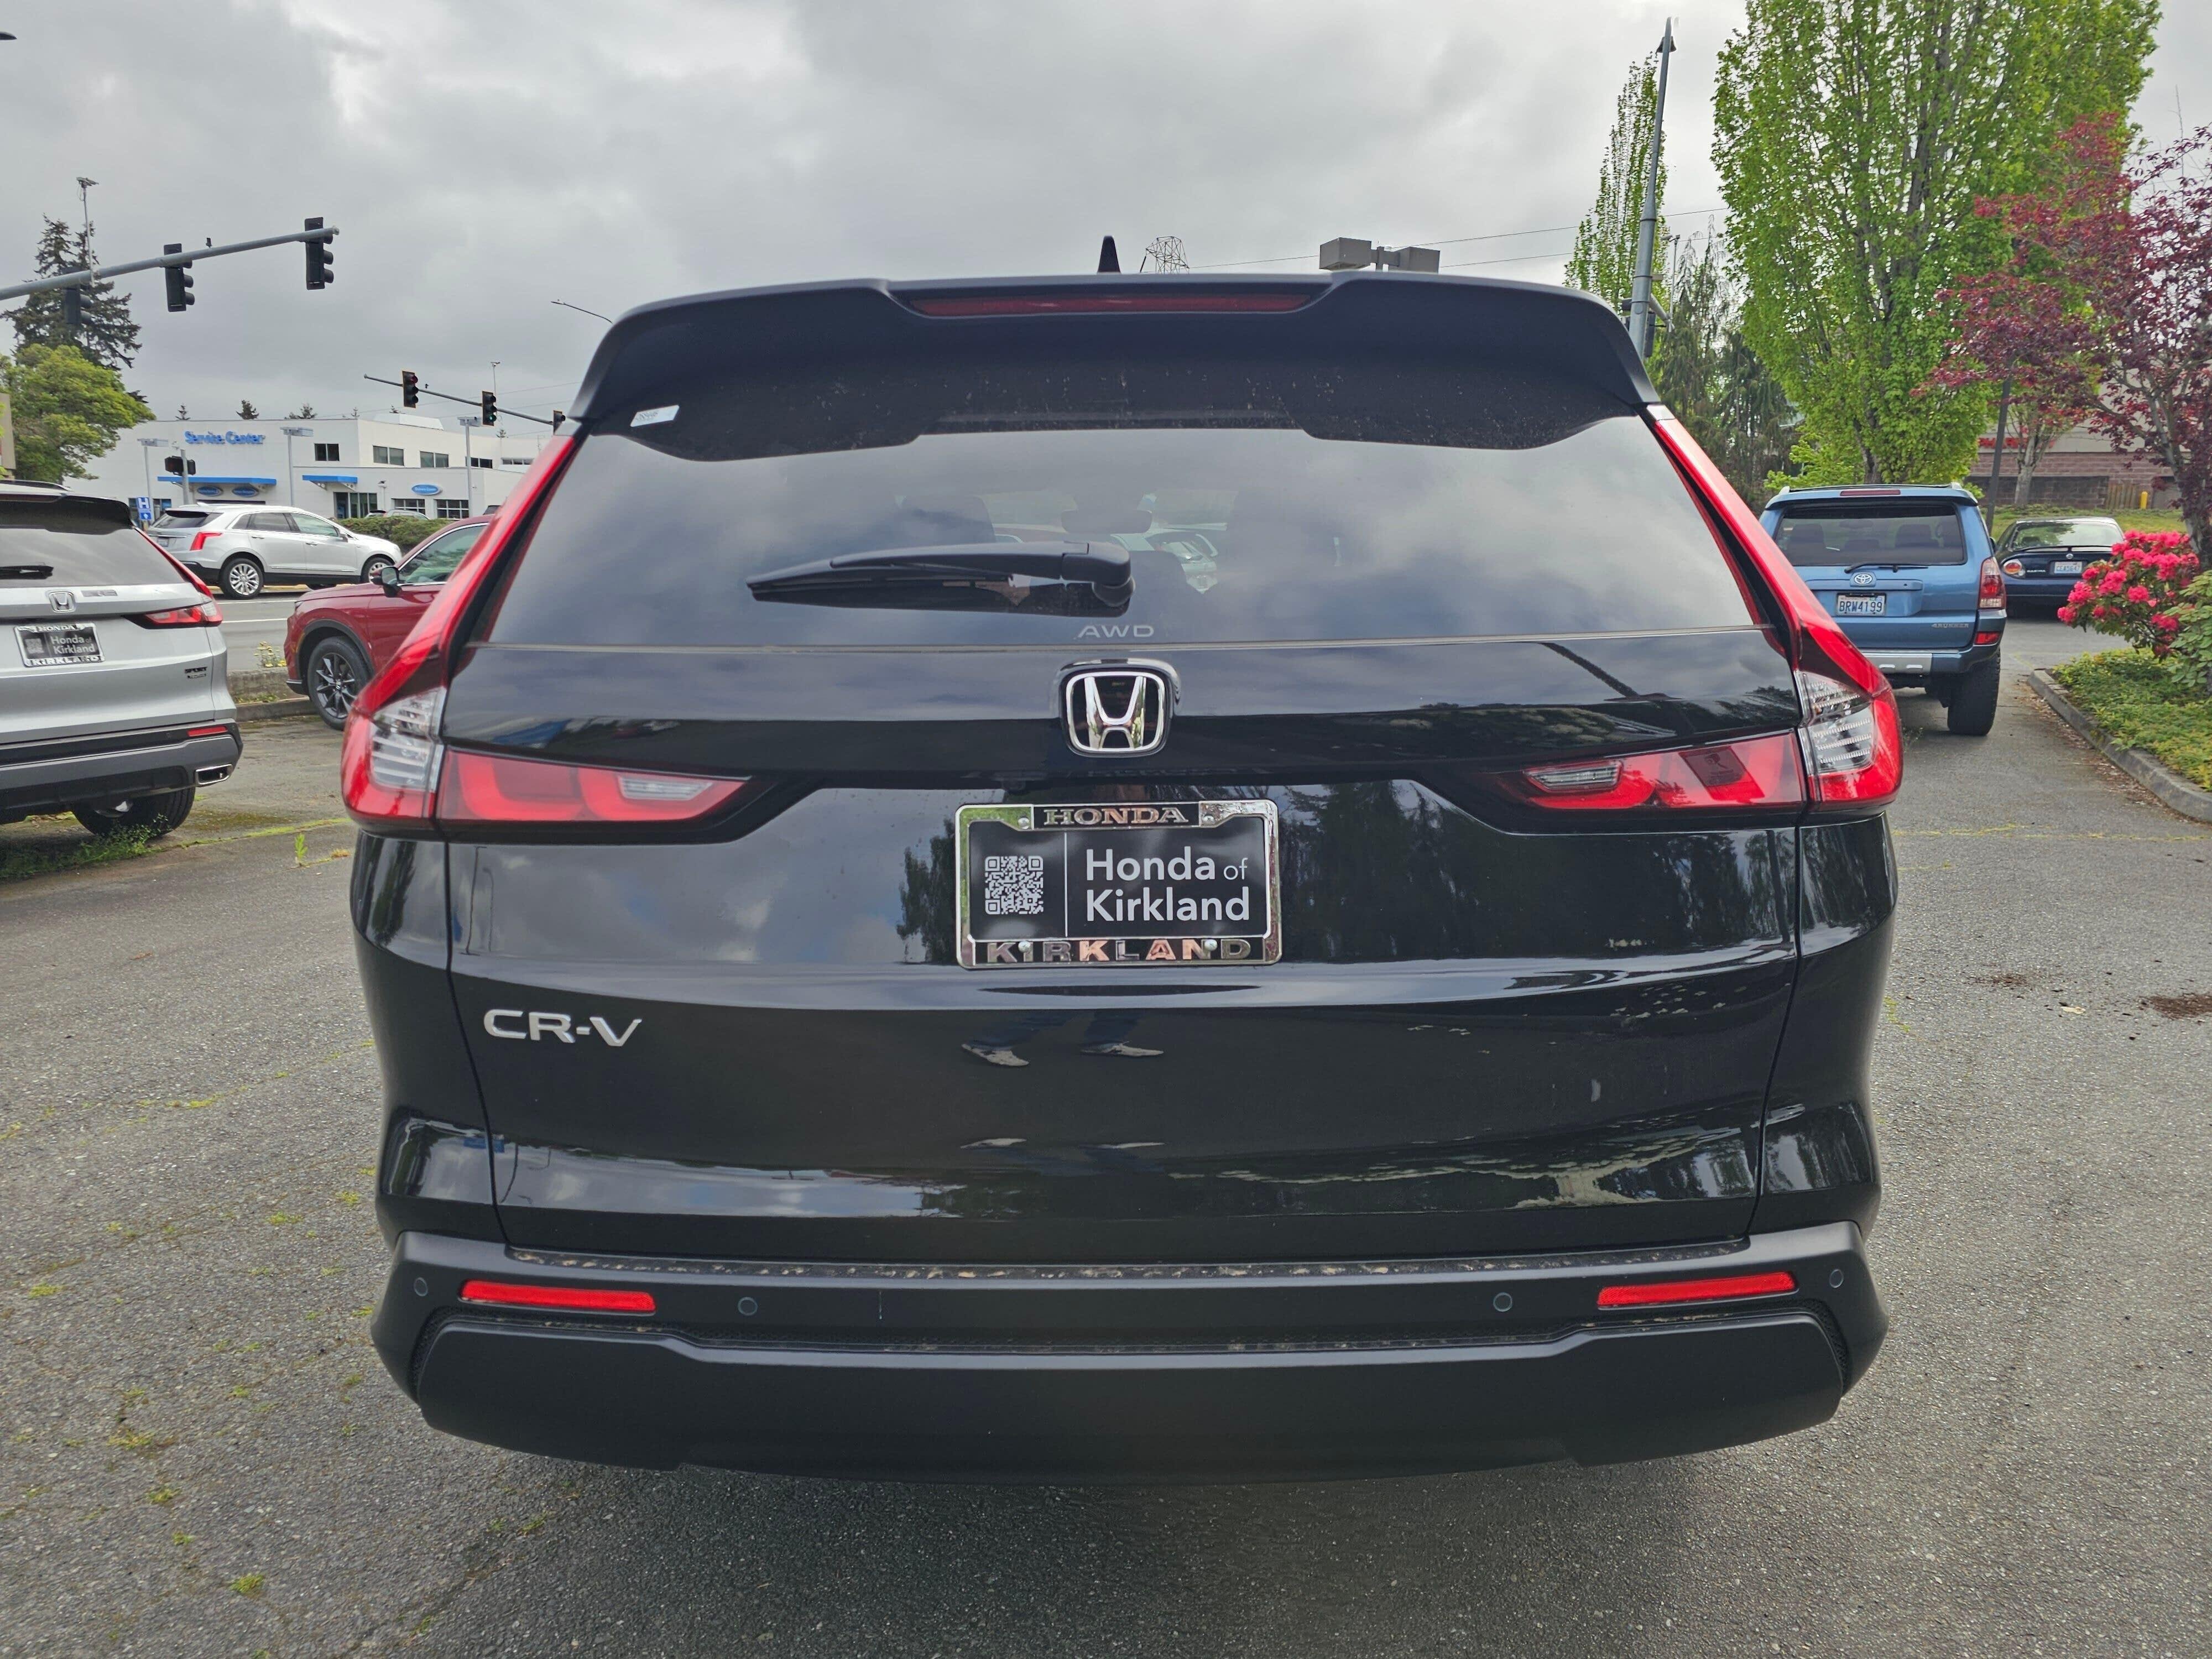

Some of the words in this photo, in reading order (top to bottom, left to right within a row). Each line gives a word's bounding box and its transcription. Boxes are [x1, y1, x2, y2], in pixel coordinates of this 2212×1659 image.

[184, 431, 225, 444] Service
[226, 431, 266, 444] Center
[1839, 601, 1882, 612] BRW4199
[1078, 624, 1154, 638] AWD
[51, 636, 84, 644] Honda
[53, 644, 96, 655] Kirkland
[1044, 807, 1188, 826] HONDA
[1086, 846, 1215, 881] Honda
[1223, 858, 1248, 880] of
[1087, 887, 1250, 922] Kirkland
[484, 1009, 642, 1046] CR-V
